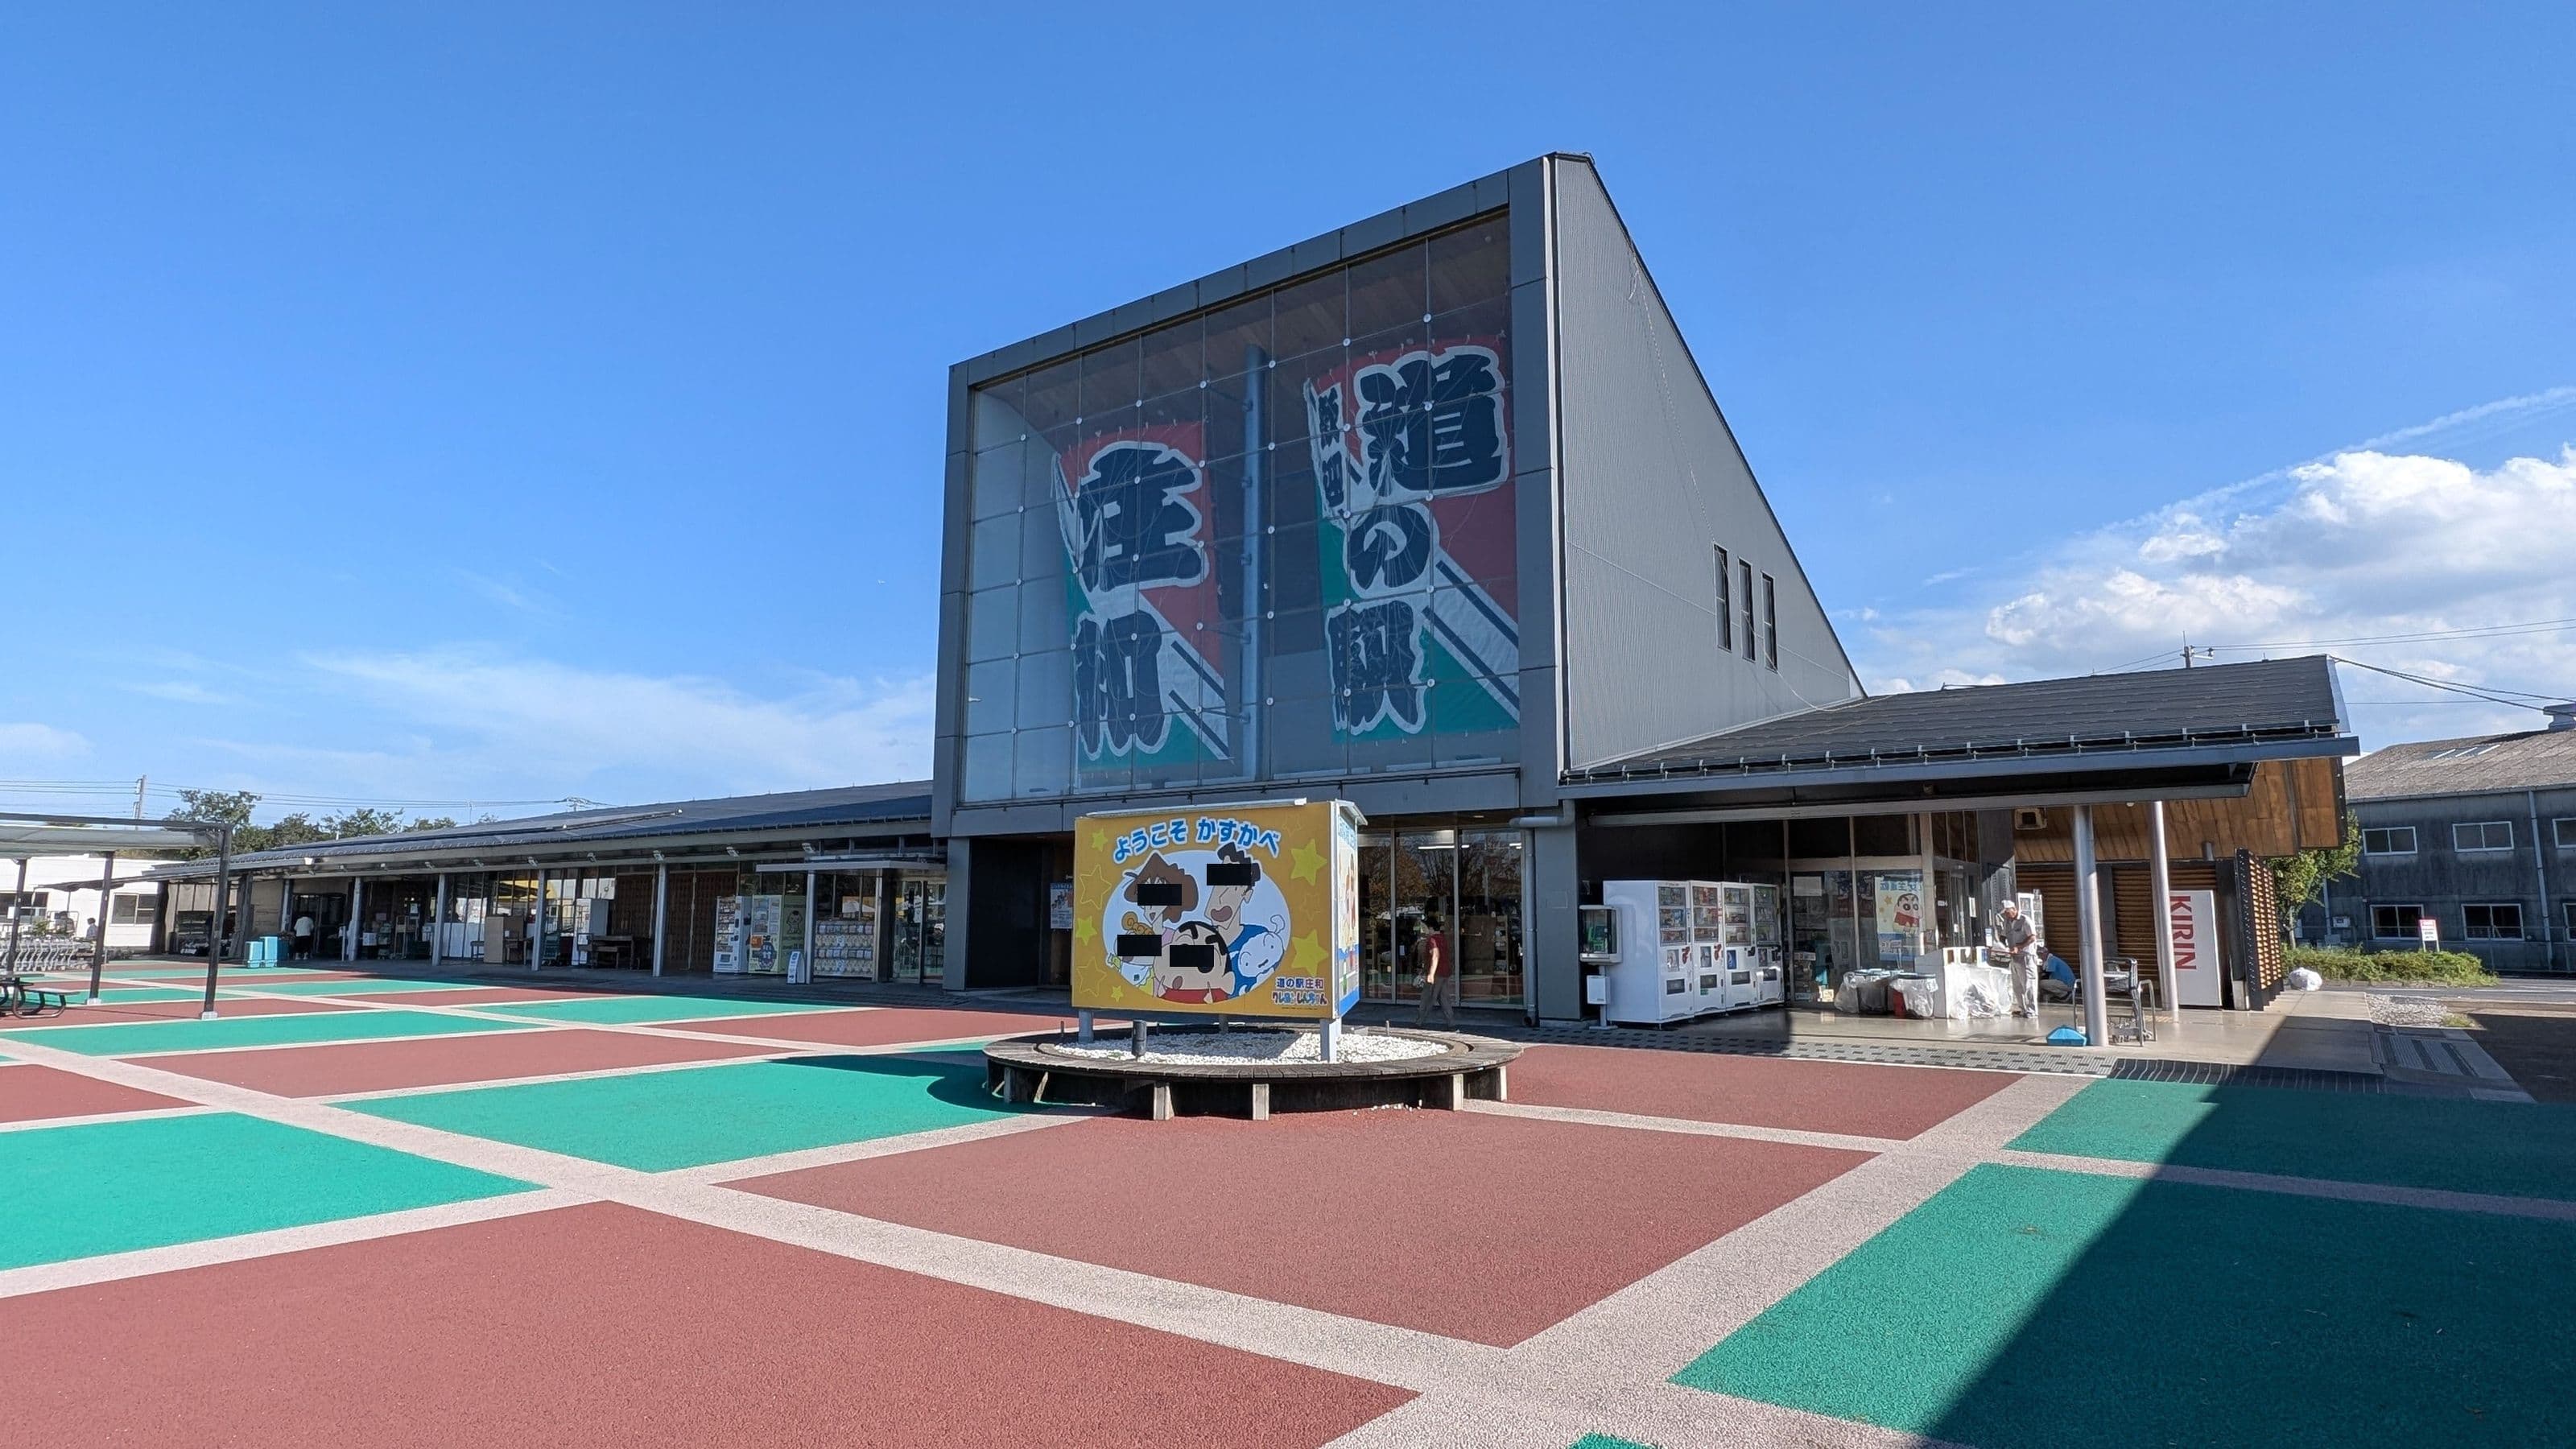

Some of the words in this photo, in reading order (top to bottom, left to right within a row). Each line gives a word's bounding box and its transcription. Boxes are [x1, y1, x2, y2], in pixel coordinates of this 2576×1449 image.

[1327, 349, 1508, 733] 道の駅
[1075, 444, 1206, 758] 庄和
[1114, 819, 1187, 862] ようこそ
[1198, 819, 1278, 857] かすかべ
[2169, 895, 2197, 970] KIRIN
[1277, 977, 1324, 989] 道の駅庄和
